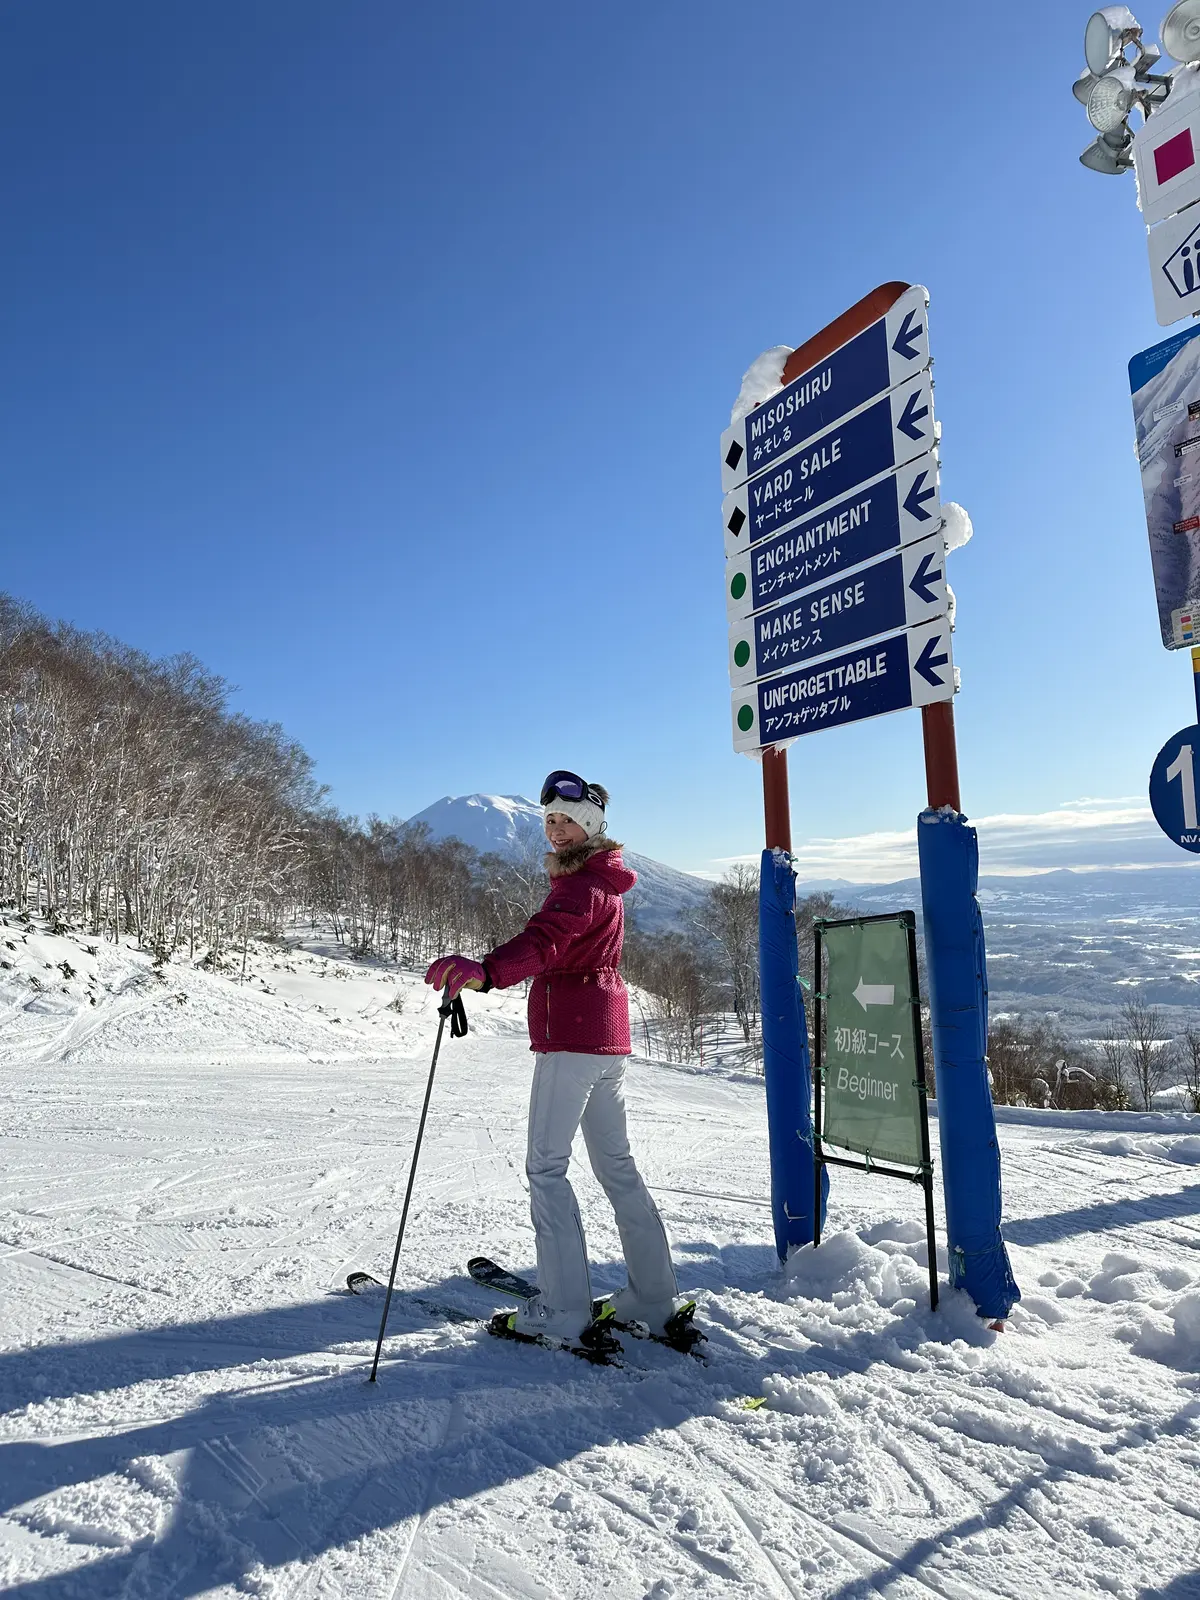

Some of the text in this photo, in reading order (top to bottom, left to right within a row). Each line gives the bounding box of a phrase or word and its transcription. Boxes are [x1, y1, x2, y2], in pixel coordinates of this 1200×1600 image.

[751, 368, 832, 441] MISOSHIRU
[753, 426, 792, 461] みそしる
[754, 438, 841, 507] YARD SALE
[755, 486, 815, 529] ヤードセール
[757, 499, 872, 576] ENCHANTMENT
[758, 546, 841, 596] エンチャントメント
[760, 581, 865, 643] MAKE SENSE
[762, 629, 823, 663] メイクセンス
[763, 652, 887, 710] UNFORGETTABLE
[765, 695, 851, 733] アンフォゲッタブル
[835, 1026, 905, 1060] 初級コース
[837, 1068, 898, 1101] Beginner
